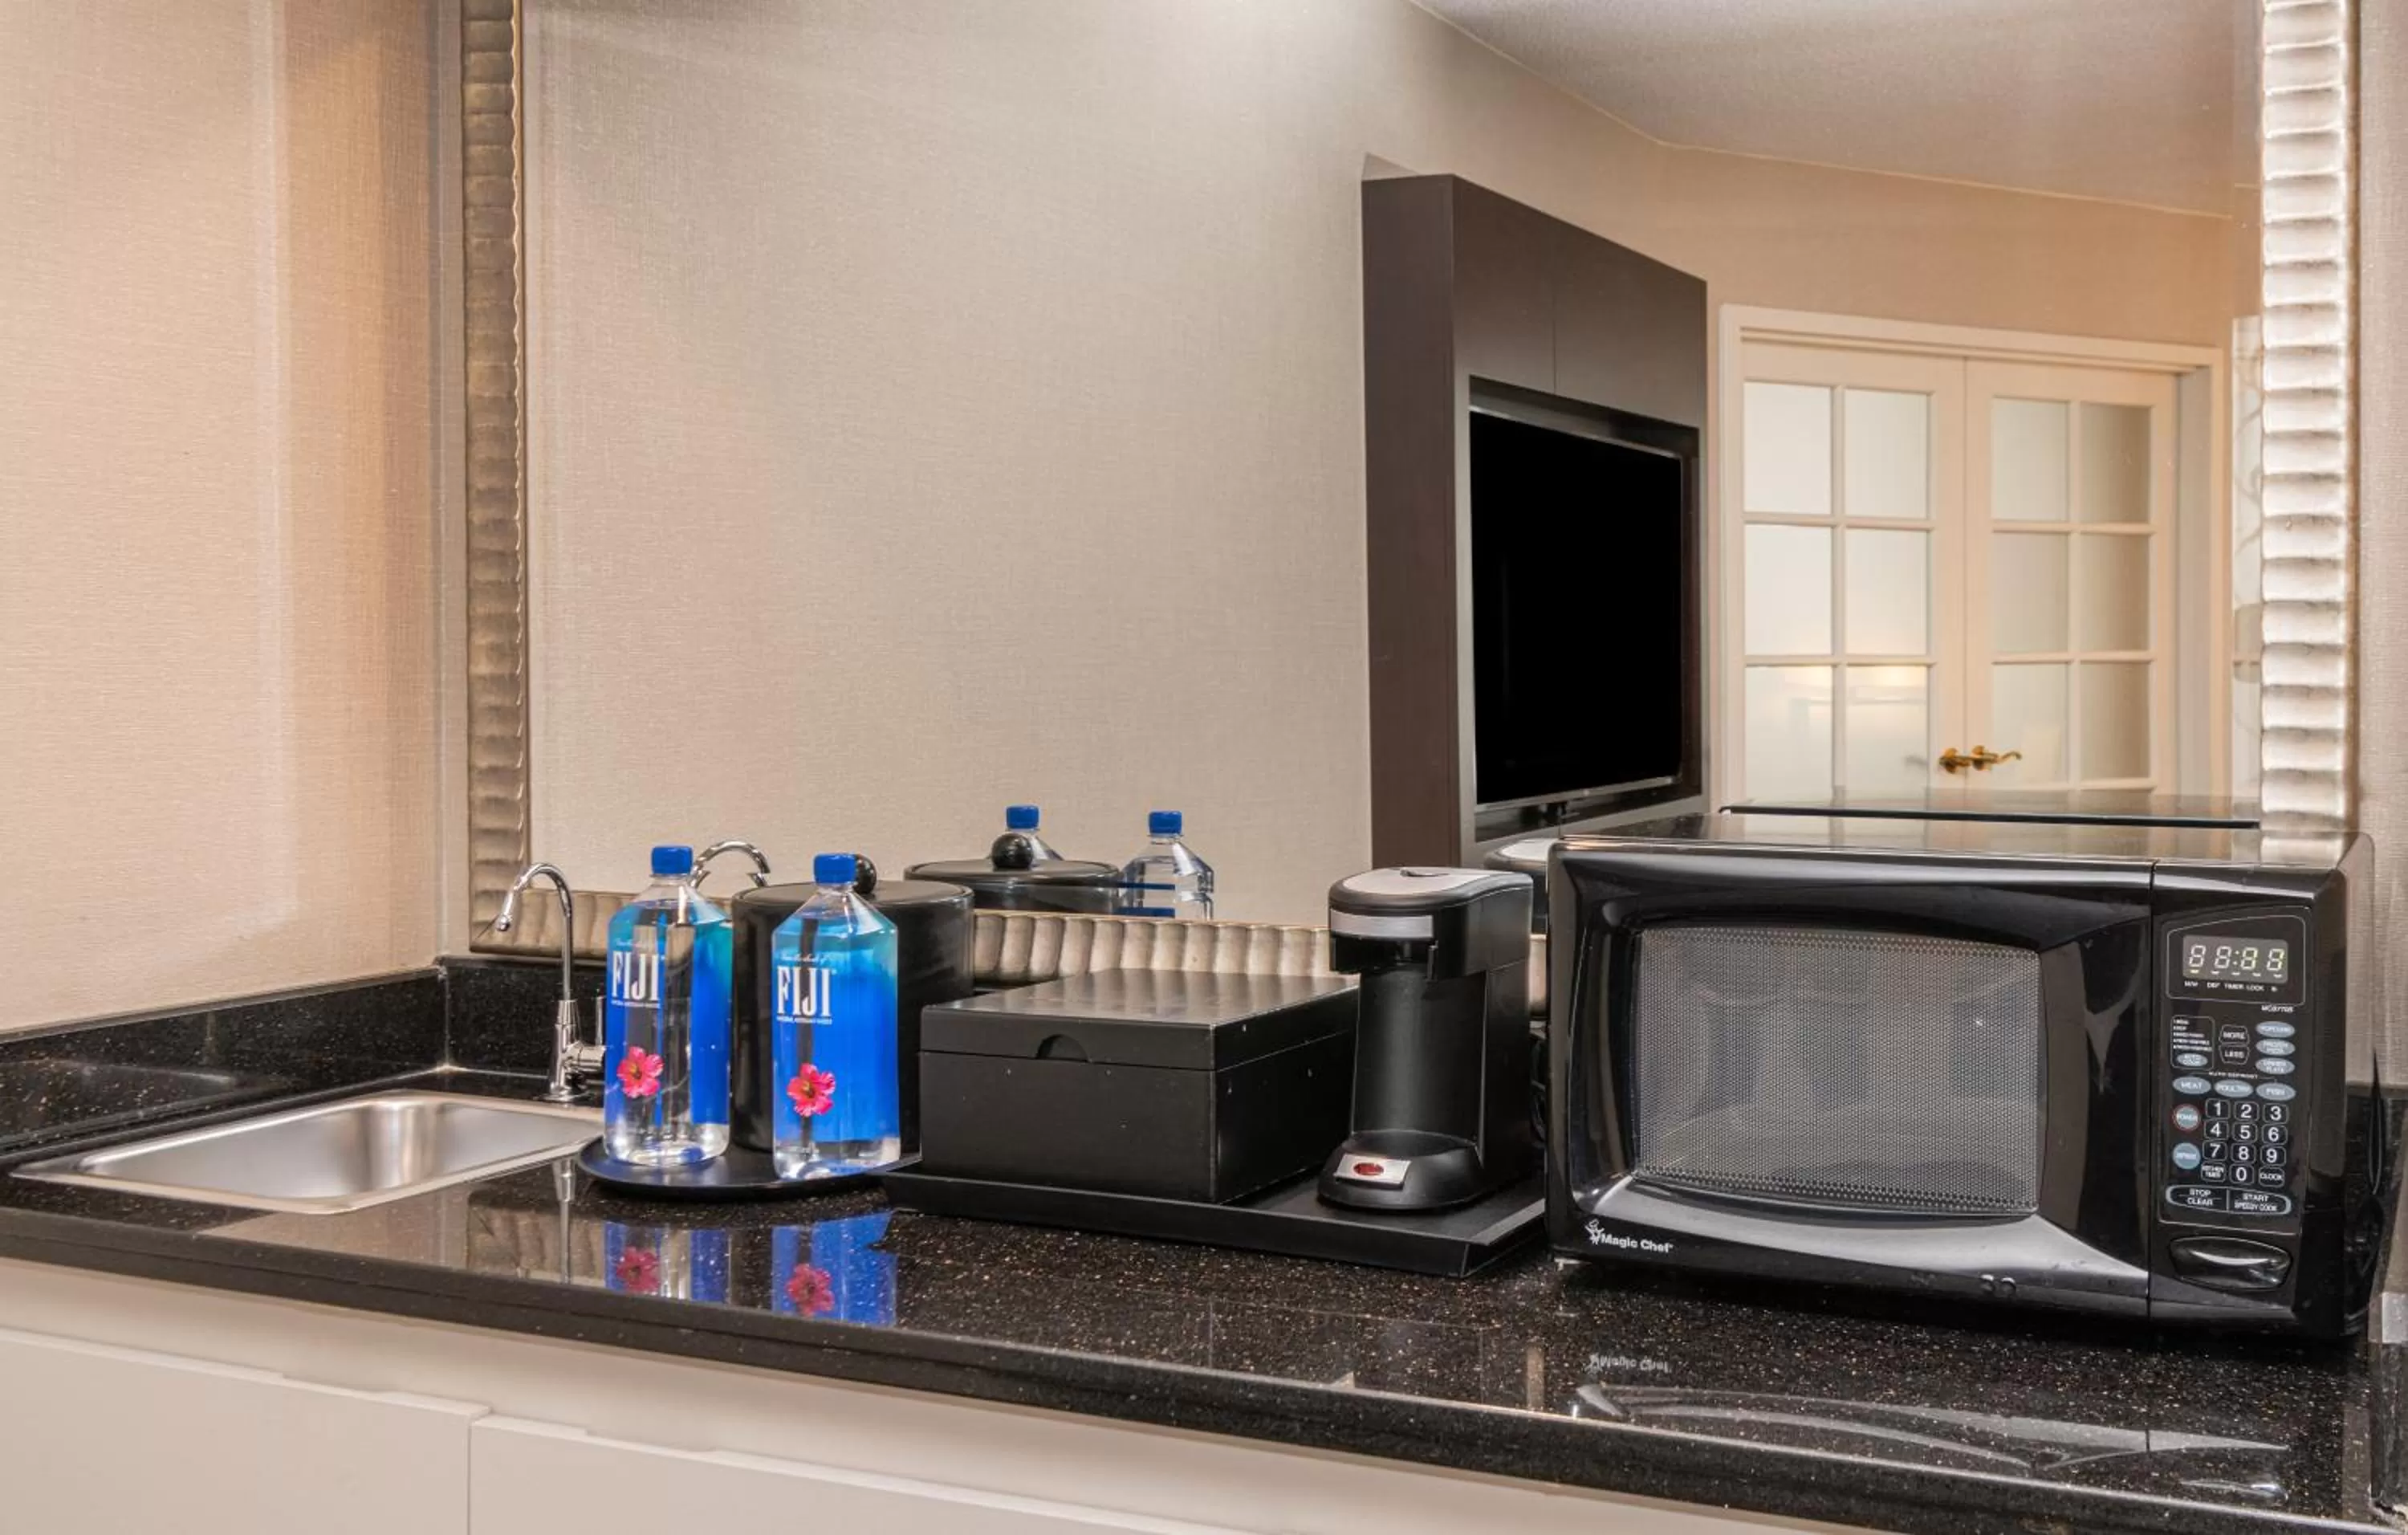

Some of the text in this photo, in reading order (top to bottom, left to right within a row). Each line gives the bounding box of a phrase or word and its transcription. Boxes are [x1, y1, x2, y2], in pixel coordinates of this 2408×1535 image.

[612, 951, 660, 1001] FIJI
[777, 965, 832, 1017] FIJI
[2223, 1032, 2246, 1040] MORE
[2224, 1049, 2245, 1059] LESS
[2180, 1081, 2203, 1089] MEAT
[2213, 1101, 2222, 1117] 1
[2240, 1104, 2252, 1118] 2
[2270, 1105, 2282, 1121] 3
[2210, 1122, 2222, 1138] 4
[2239, 1125, 2251, 1139] 5
[2268, 1127, 2280, 1142] 6
[2210, 1142, 2221, 1158] 7
[2238, 1146, 2249, 1160] 8
[2266, 1148, 2277, 1163] 9
[2235, 1167, 2247, 1182] 0
[2260, 1172, 2284, 1180] CLOCK
[2189, 1188, 2211, 1197] STOP
[2243, 1193, 2269, 1203] START
[2186, 1197, 2213, 1206] CLEAR
[2260, 1203, 2277, 1211] COOK
[1601, 1234, 1669, 1253] Magic Chef
